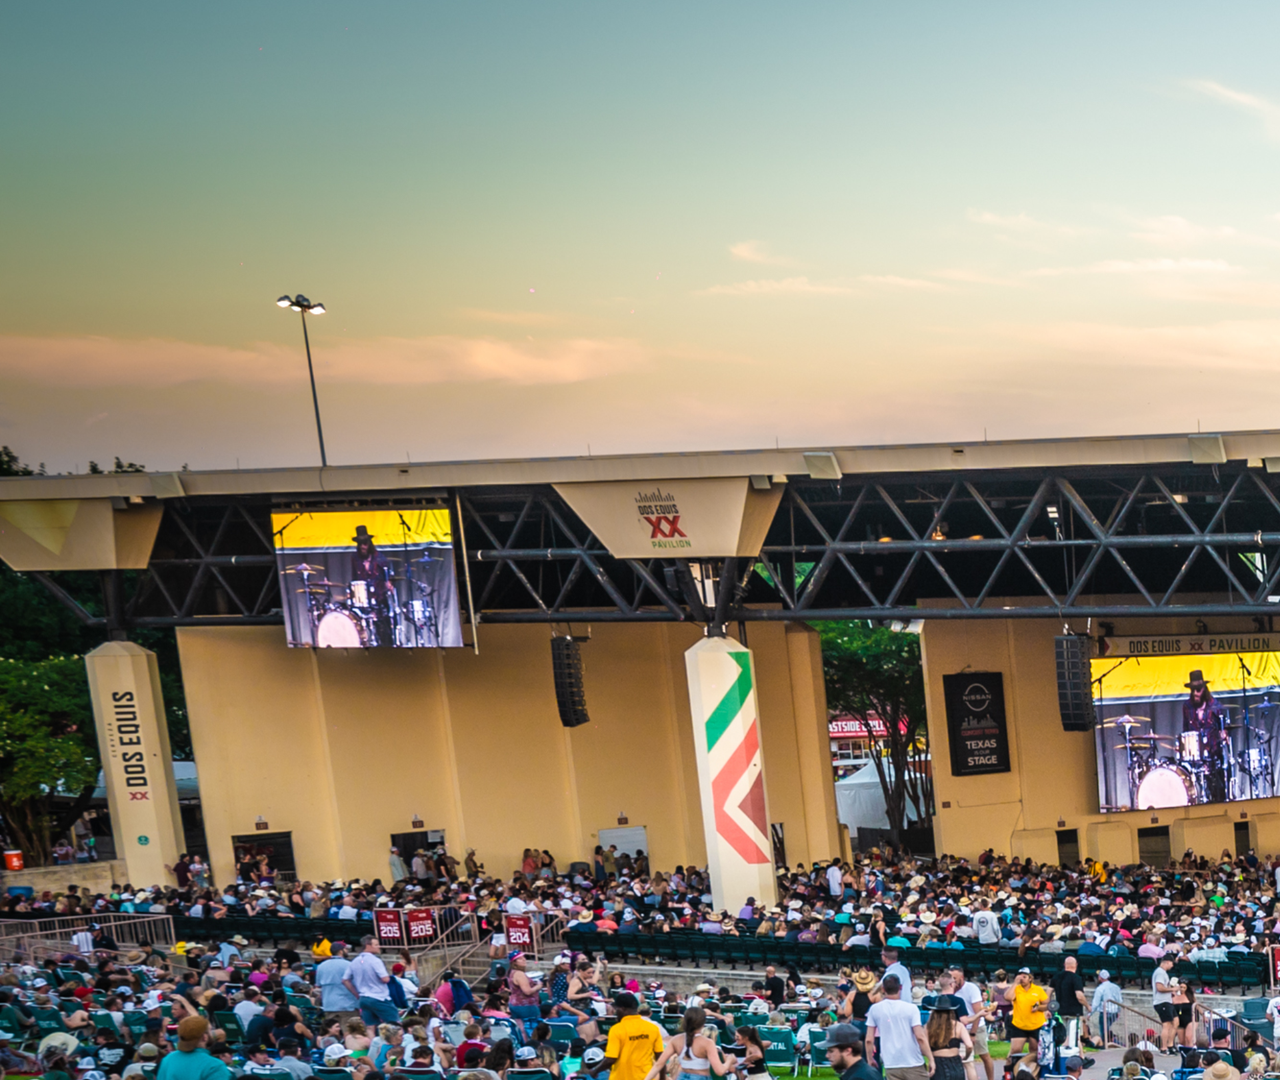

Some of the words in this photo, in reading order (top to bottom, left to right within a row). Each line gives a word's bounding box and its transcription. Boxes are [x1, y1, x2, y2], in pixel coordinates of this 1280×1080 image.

[638, 504, 655, 516] DOS
[657, 503, 680, 515] EQUIS
[643, 515, 688, 538] XX
[652, 540, 692, 550] PAVILION
[1130, 641, 1148, 653] DOS
[1152, 640, 1181, 653] EQUIS
[1211, 638, 1270, 651] PAVILION
[112, 691, 142, 747] EQUIS
[965, 739, 997, 750] TEXAS
[967, 755, 998, 766] STAGE
[120, 749, 148, 788] DOS
[380, 926, 400, 937] 205
[411, 924, 433, 937] 205
[510, 932, 531, 943] 204
